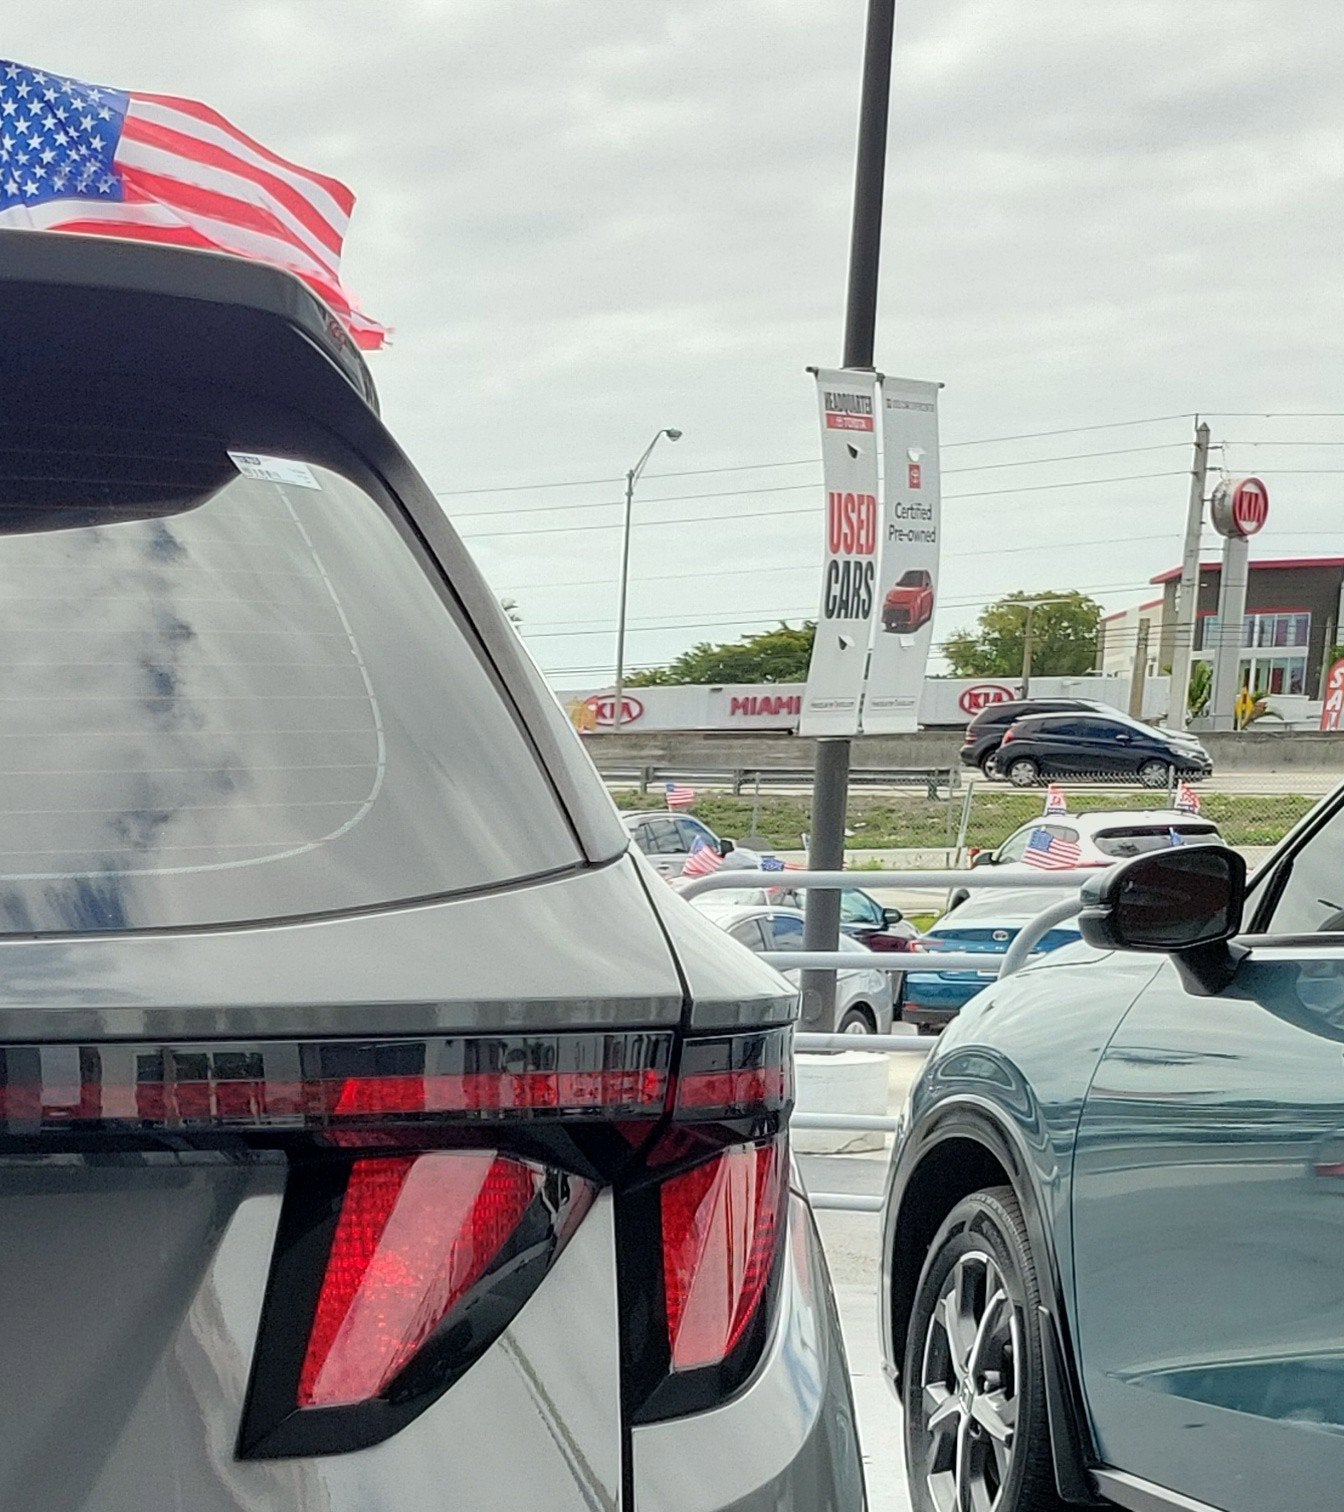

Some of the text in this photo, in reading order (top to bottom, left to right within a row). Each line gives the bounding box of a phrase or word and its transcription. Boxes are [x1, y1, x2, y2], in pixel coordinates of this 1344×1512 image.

[894, 501, 932, 521] Certified
[1238, 490, 1262, 523] KIA
[828, 491, 877, 555] USED
[888, 524, 937, 543] Pre-owned
[824, 559, 875, 620] CARS
[730, 696, 801, 716] MIAMI
